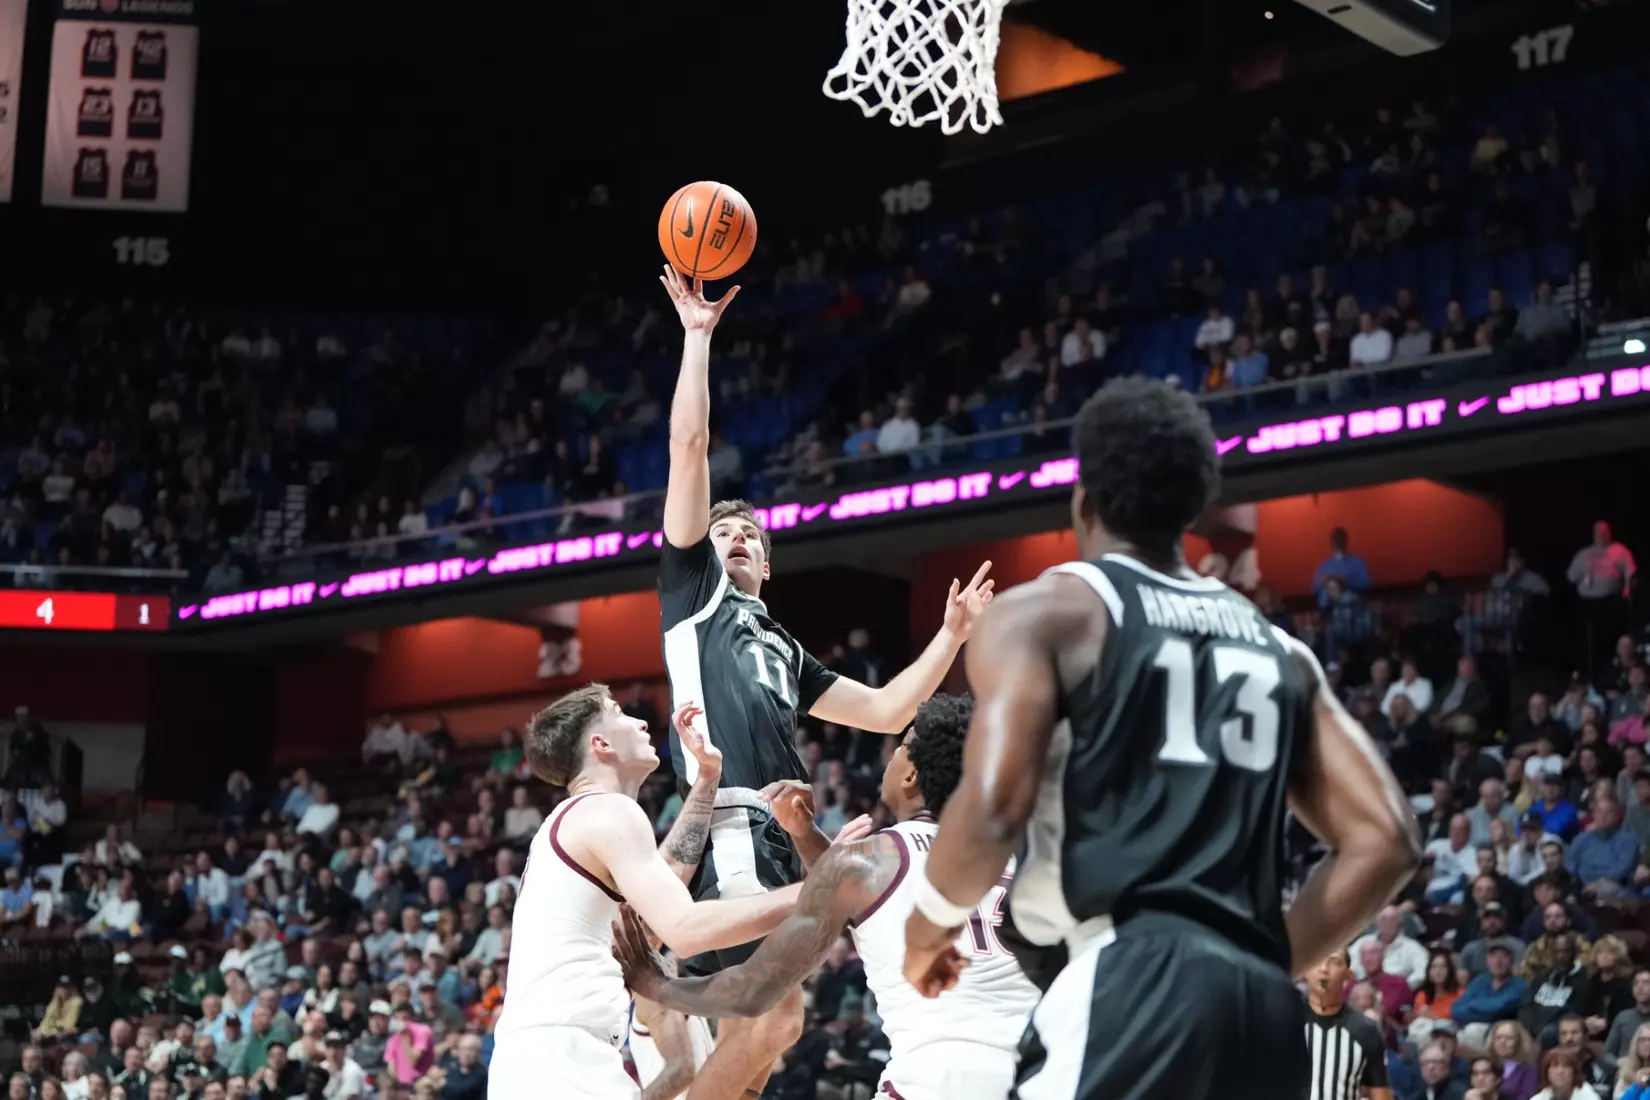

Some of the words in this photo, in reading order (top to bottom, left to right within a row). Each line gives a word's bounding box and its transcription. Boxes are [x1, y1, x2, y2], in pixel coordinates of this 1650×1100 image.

[1511, 24, 1574, 69] 117
[881, 180, 931, 215] 116
[709, 199, 736, 250] ELITE
[112, 236, 170, 266] 115
[1497, 373, 1606, 413] JUST
[1246, 415, 1345, 454] JUST
[1348, 407, 1403, 438] DO
[1407, 399, 1447, 428] IT
[770, 503, 802, 530] IT
[829, 485, 911, 519] JUST
[959, 472, 993, 499] IT
[439, 558, 469, 582] IT
[488, 543, 556, 574] JUST
[595, 532, 623, 557] IT
[36, 597, 54, 625] 4
[139, 603, 149, 625] 1
[1136, 583, 1268, 646] HARGROVE
[736, 607, 794, 664] PROVIDENCE
[745, 643, 796, 709] 11
[1153, 637, 1281, 772] 13
